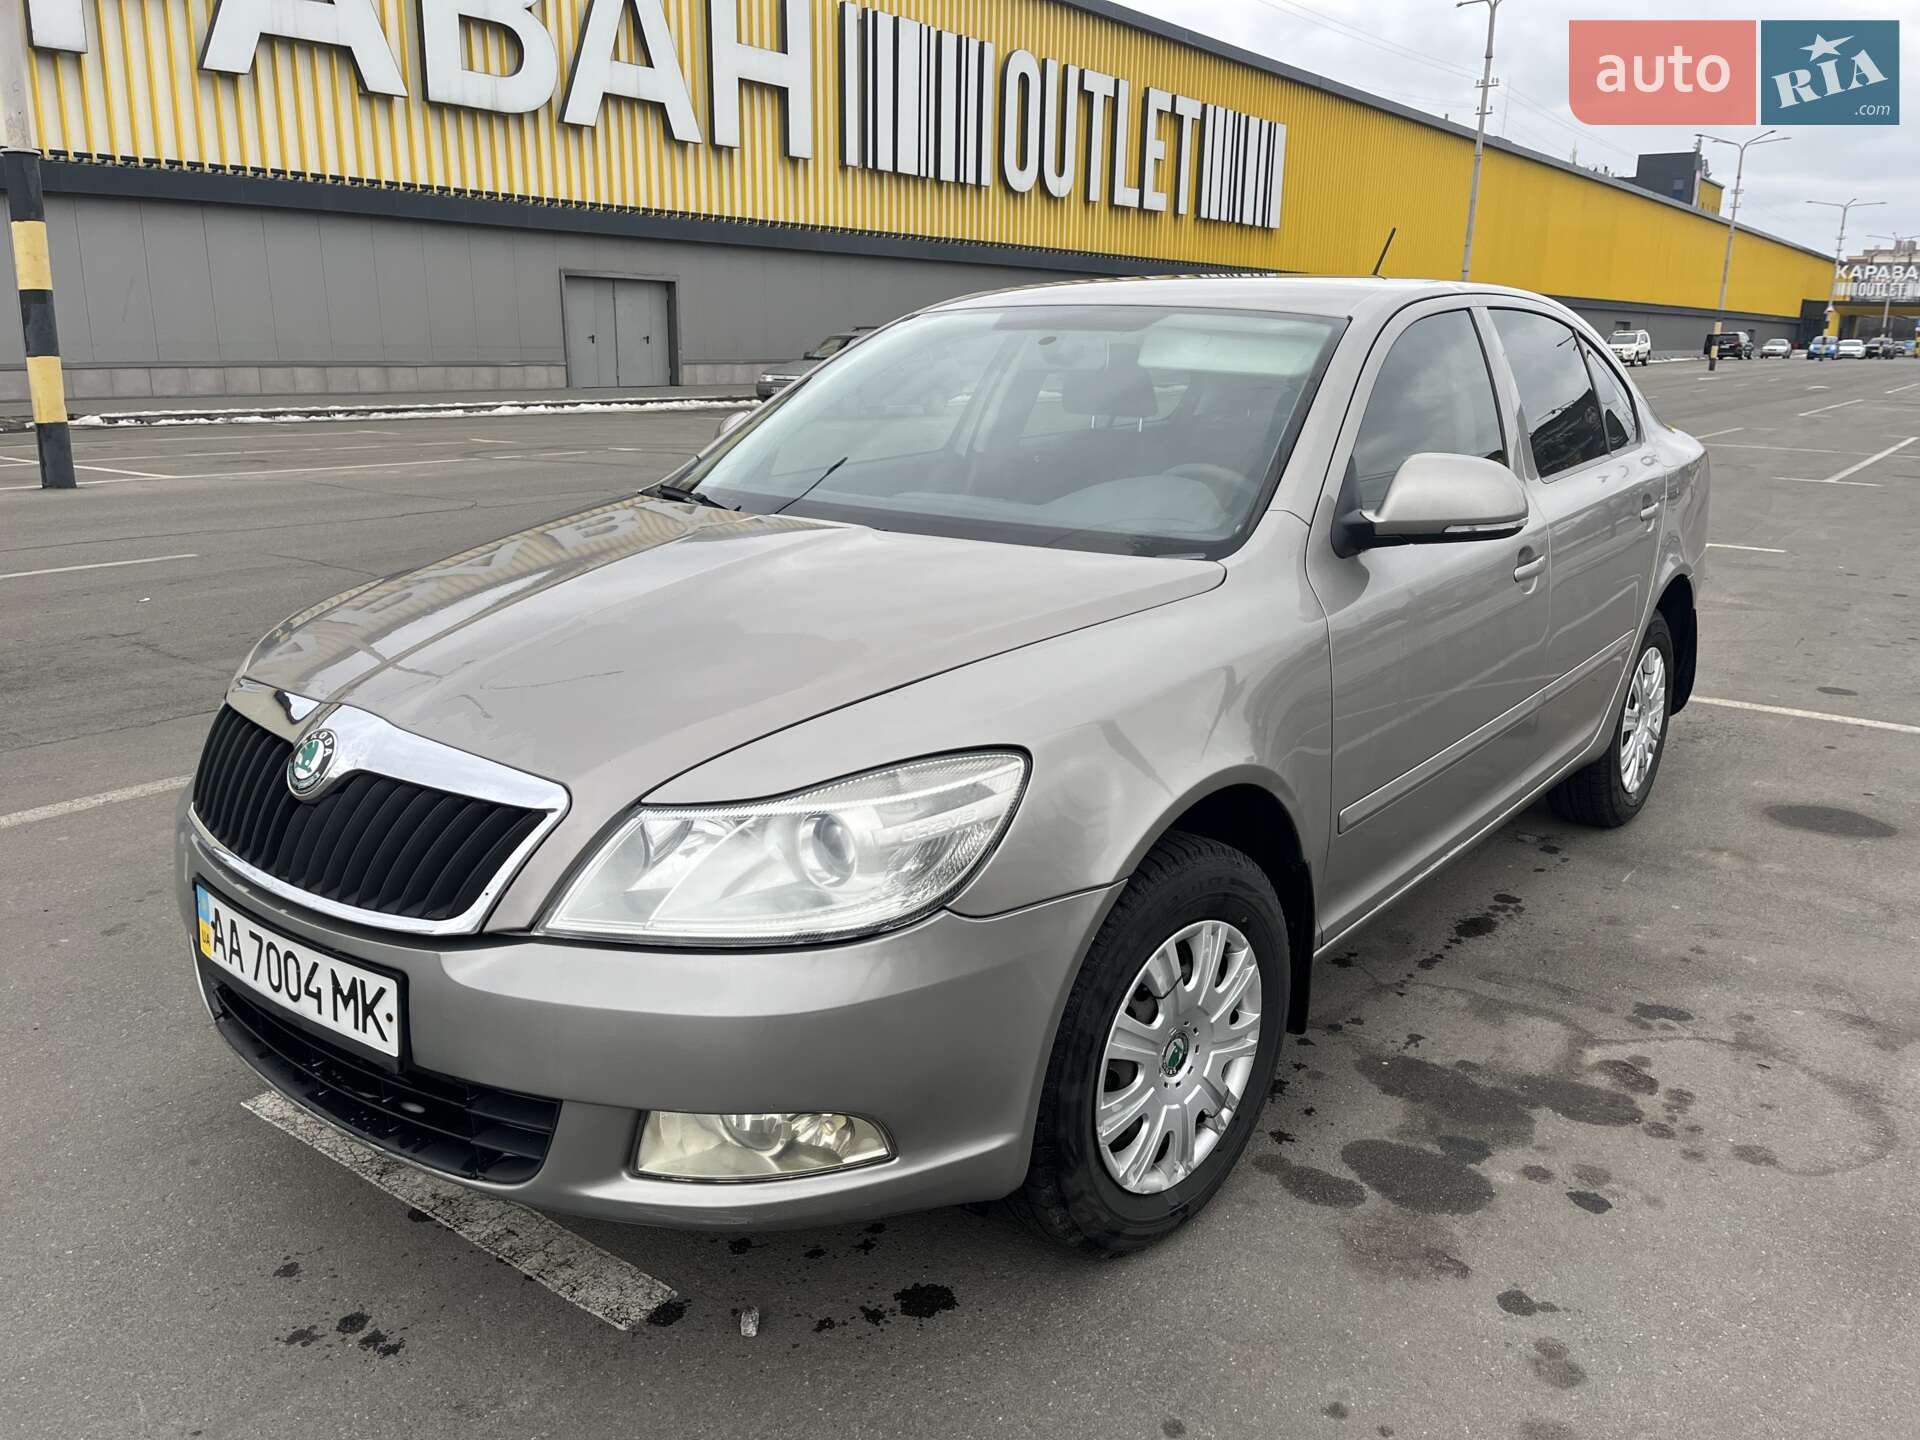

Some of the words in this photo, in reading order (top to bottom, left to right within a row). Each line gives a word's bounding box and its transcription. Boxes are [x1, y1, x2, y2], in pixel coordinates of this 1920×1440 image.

[1002, 49, 1200, 215] OUTLET
[1858, 282, 1905, 297] OUTLET
[213, 908, 244, 973] AA
[249, 929, 322, 1016] 7004
[330, 967, 388, 1042] MK
